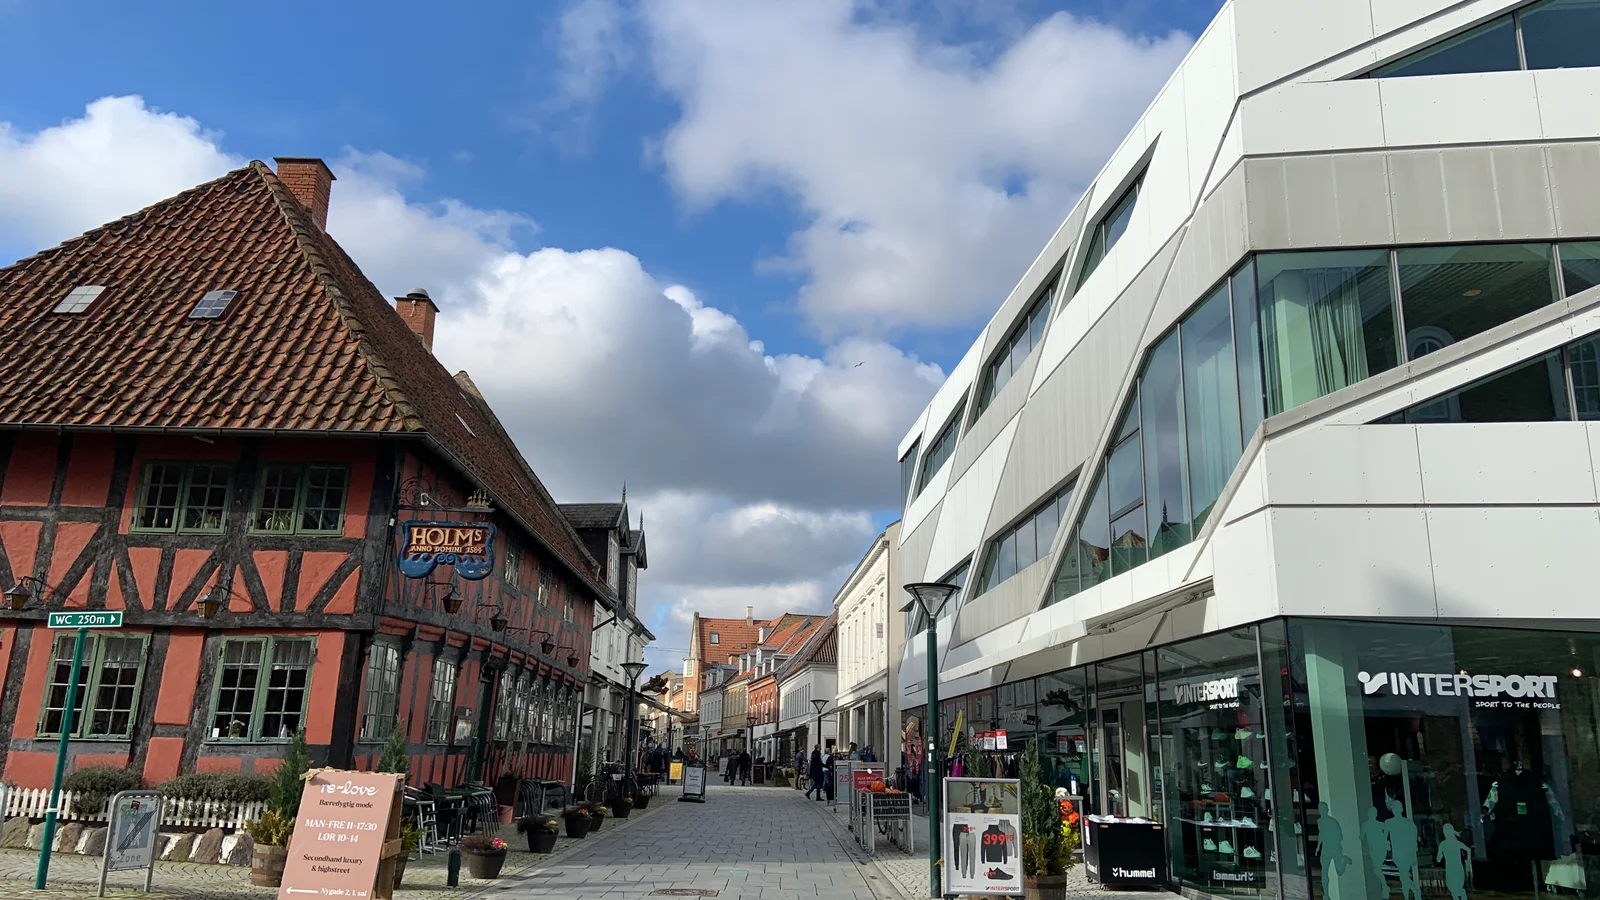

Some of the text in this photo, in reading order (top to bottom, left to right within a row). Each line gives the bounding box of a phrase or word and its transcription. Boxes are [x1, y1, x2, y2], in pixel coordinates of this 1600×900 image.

[55, 614, 105, 625] WC 250m
[1183, 677, 1238, 703] INTERSPORT
[1390, 672, 1557, 698] INTERSPORT
[1515, 701, 1530, 709] THE
[1533, 702, 1561, 710] PEOPLE
[320, 781, 379, 796] re-love
[319, 799, 374, 809] Bæredygtig mode
[305, 819, 378, 831] MAN-FRE 11-17:30
[317, 832, 359, 843] LØR 10-14
[120, 854, 141, 863] Zone
[303, 853, 364, 865] Secondhand luxury
[317, 865, 350, 874] highstreet
[1119, 867, 1156, 878] hummel
[320, 887, 344, 896] Nygade
